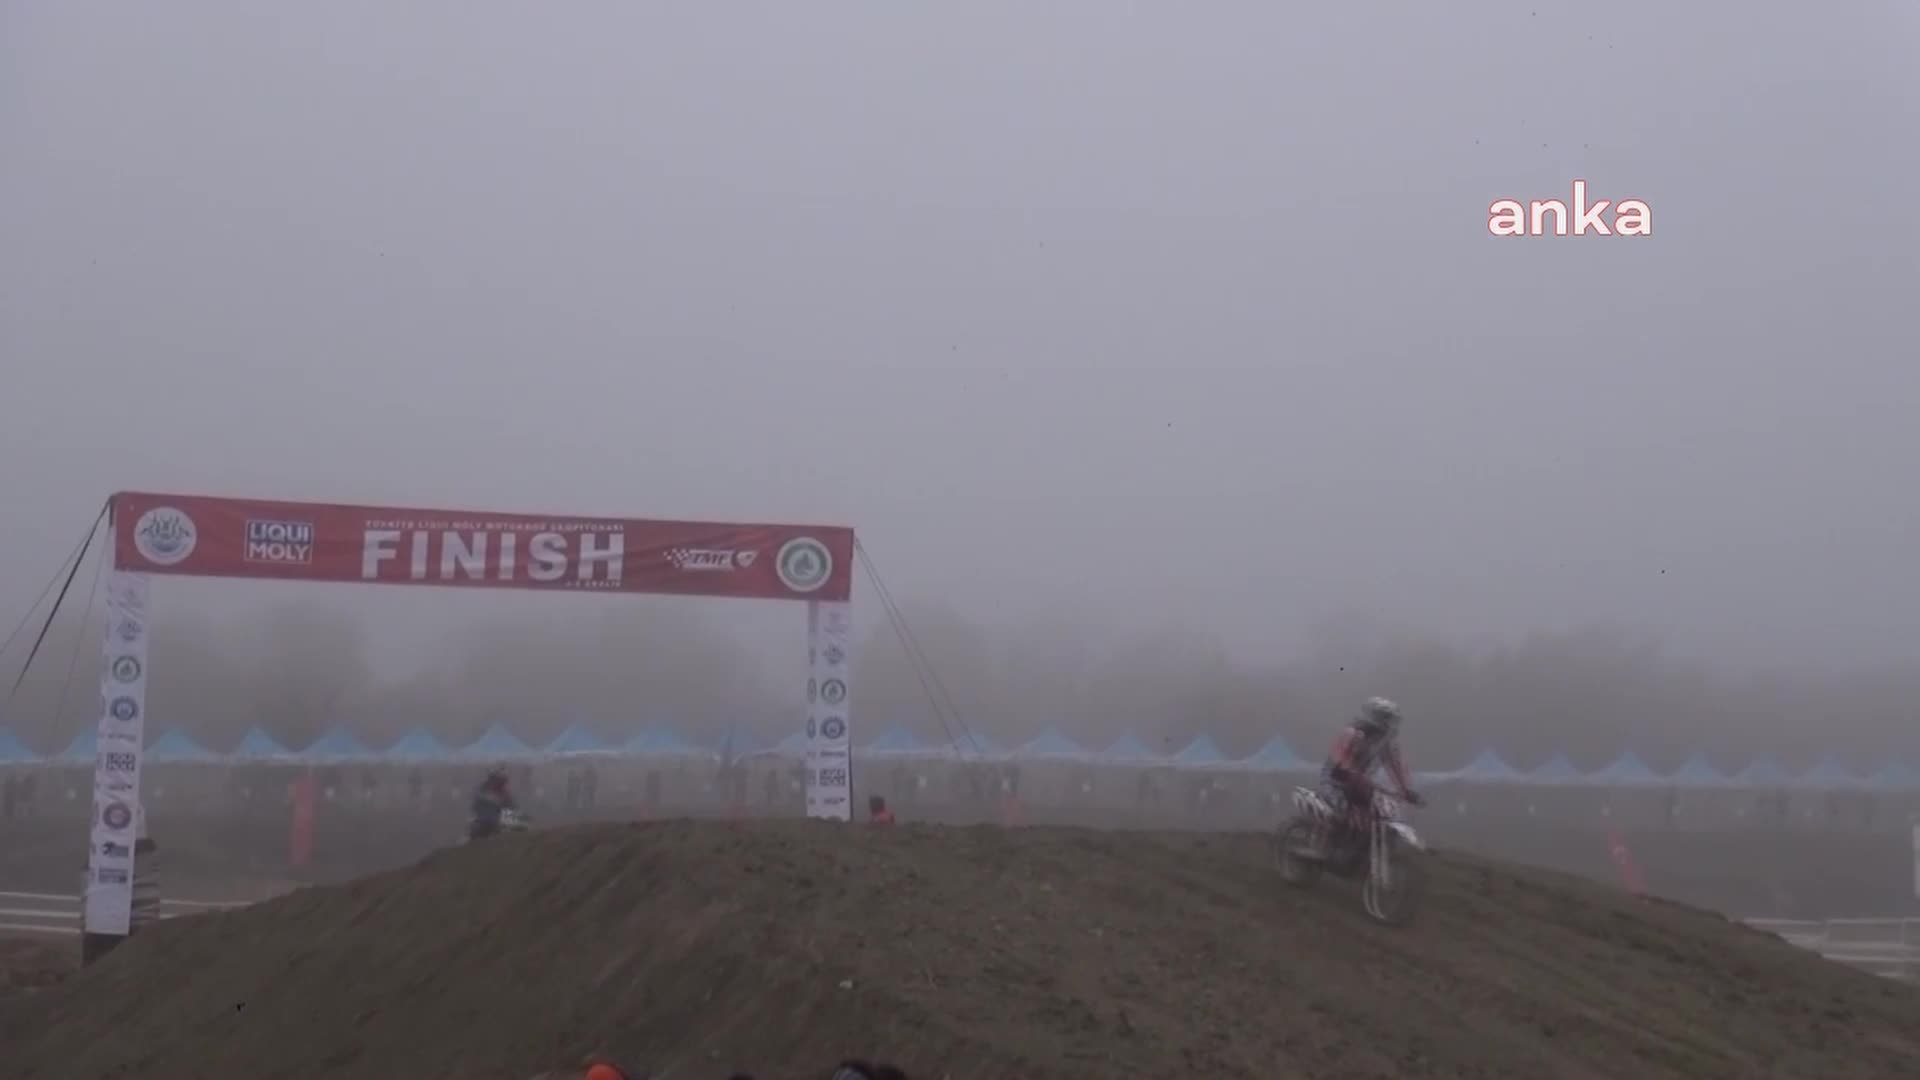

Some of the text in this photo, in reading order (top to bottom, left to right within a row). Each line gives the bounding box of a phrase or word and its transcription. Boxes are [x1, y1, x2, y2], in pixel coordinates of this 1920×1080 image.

[249, 522, 309, 541] LIQUI
[248, 541, 310, 560] MOLY
[361, 530, 624, 580] FINISH
